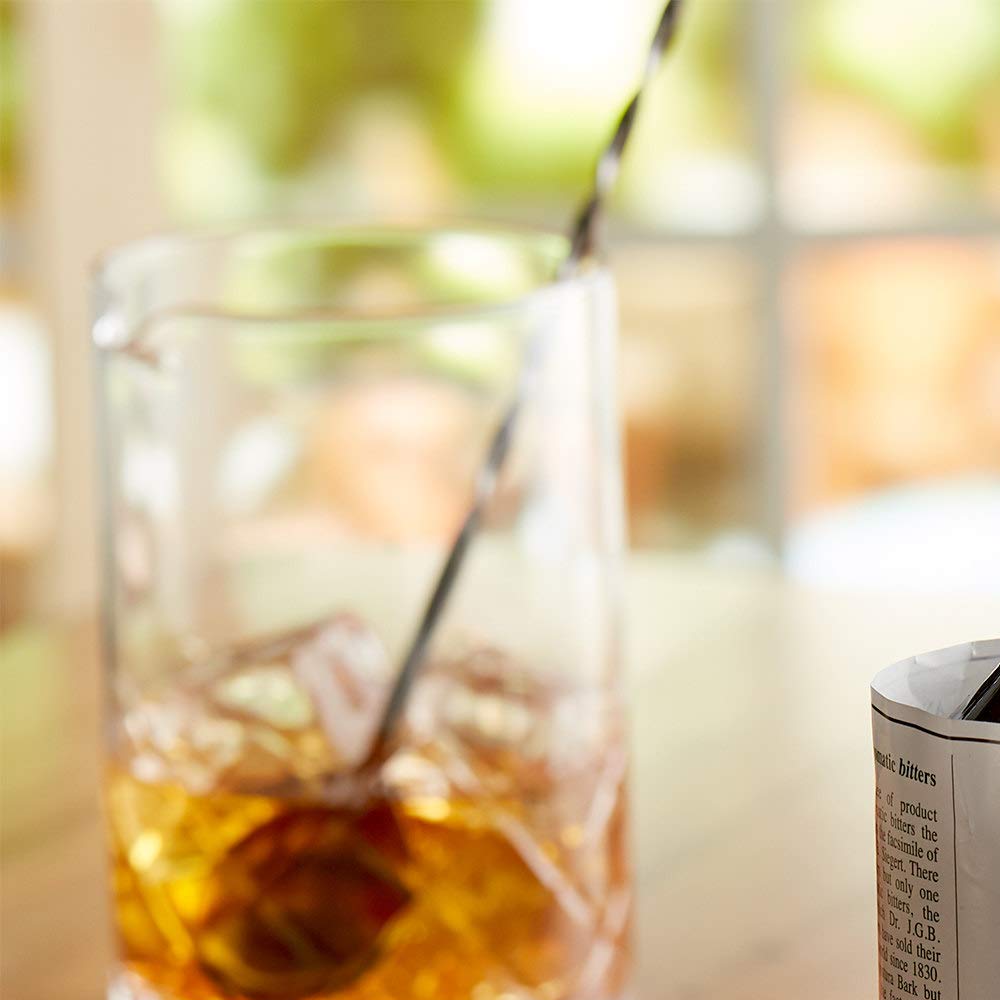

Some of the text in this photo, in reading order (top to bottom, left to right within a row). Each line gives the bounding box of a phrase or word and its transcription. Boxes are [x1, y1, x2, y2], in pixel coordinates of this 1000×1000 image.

[899, 757, 936, 787] bitters
[900, 801, 938, 823] product
[890, 812, 915, 836] bitters
[921, 825, 938, 842] the
[927, 847, 939, 862] of
[909, 860, 939, 882] There
[895, 878, 914, 899] only
[920, 888, 939, 902] one
[922, 905, 940, 922] the
[889, 910, 941, 942] Dr. J.G.B.
[896, 938, 912, 954] sold
[917, 943, 941, 963] their
[890, 952, 941, 983] since 1830.
[897, 974, 918, 996] Bark
